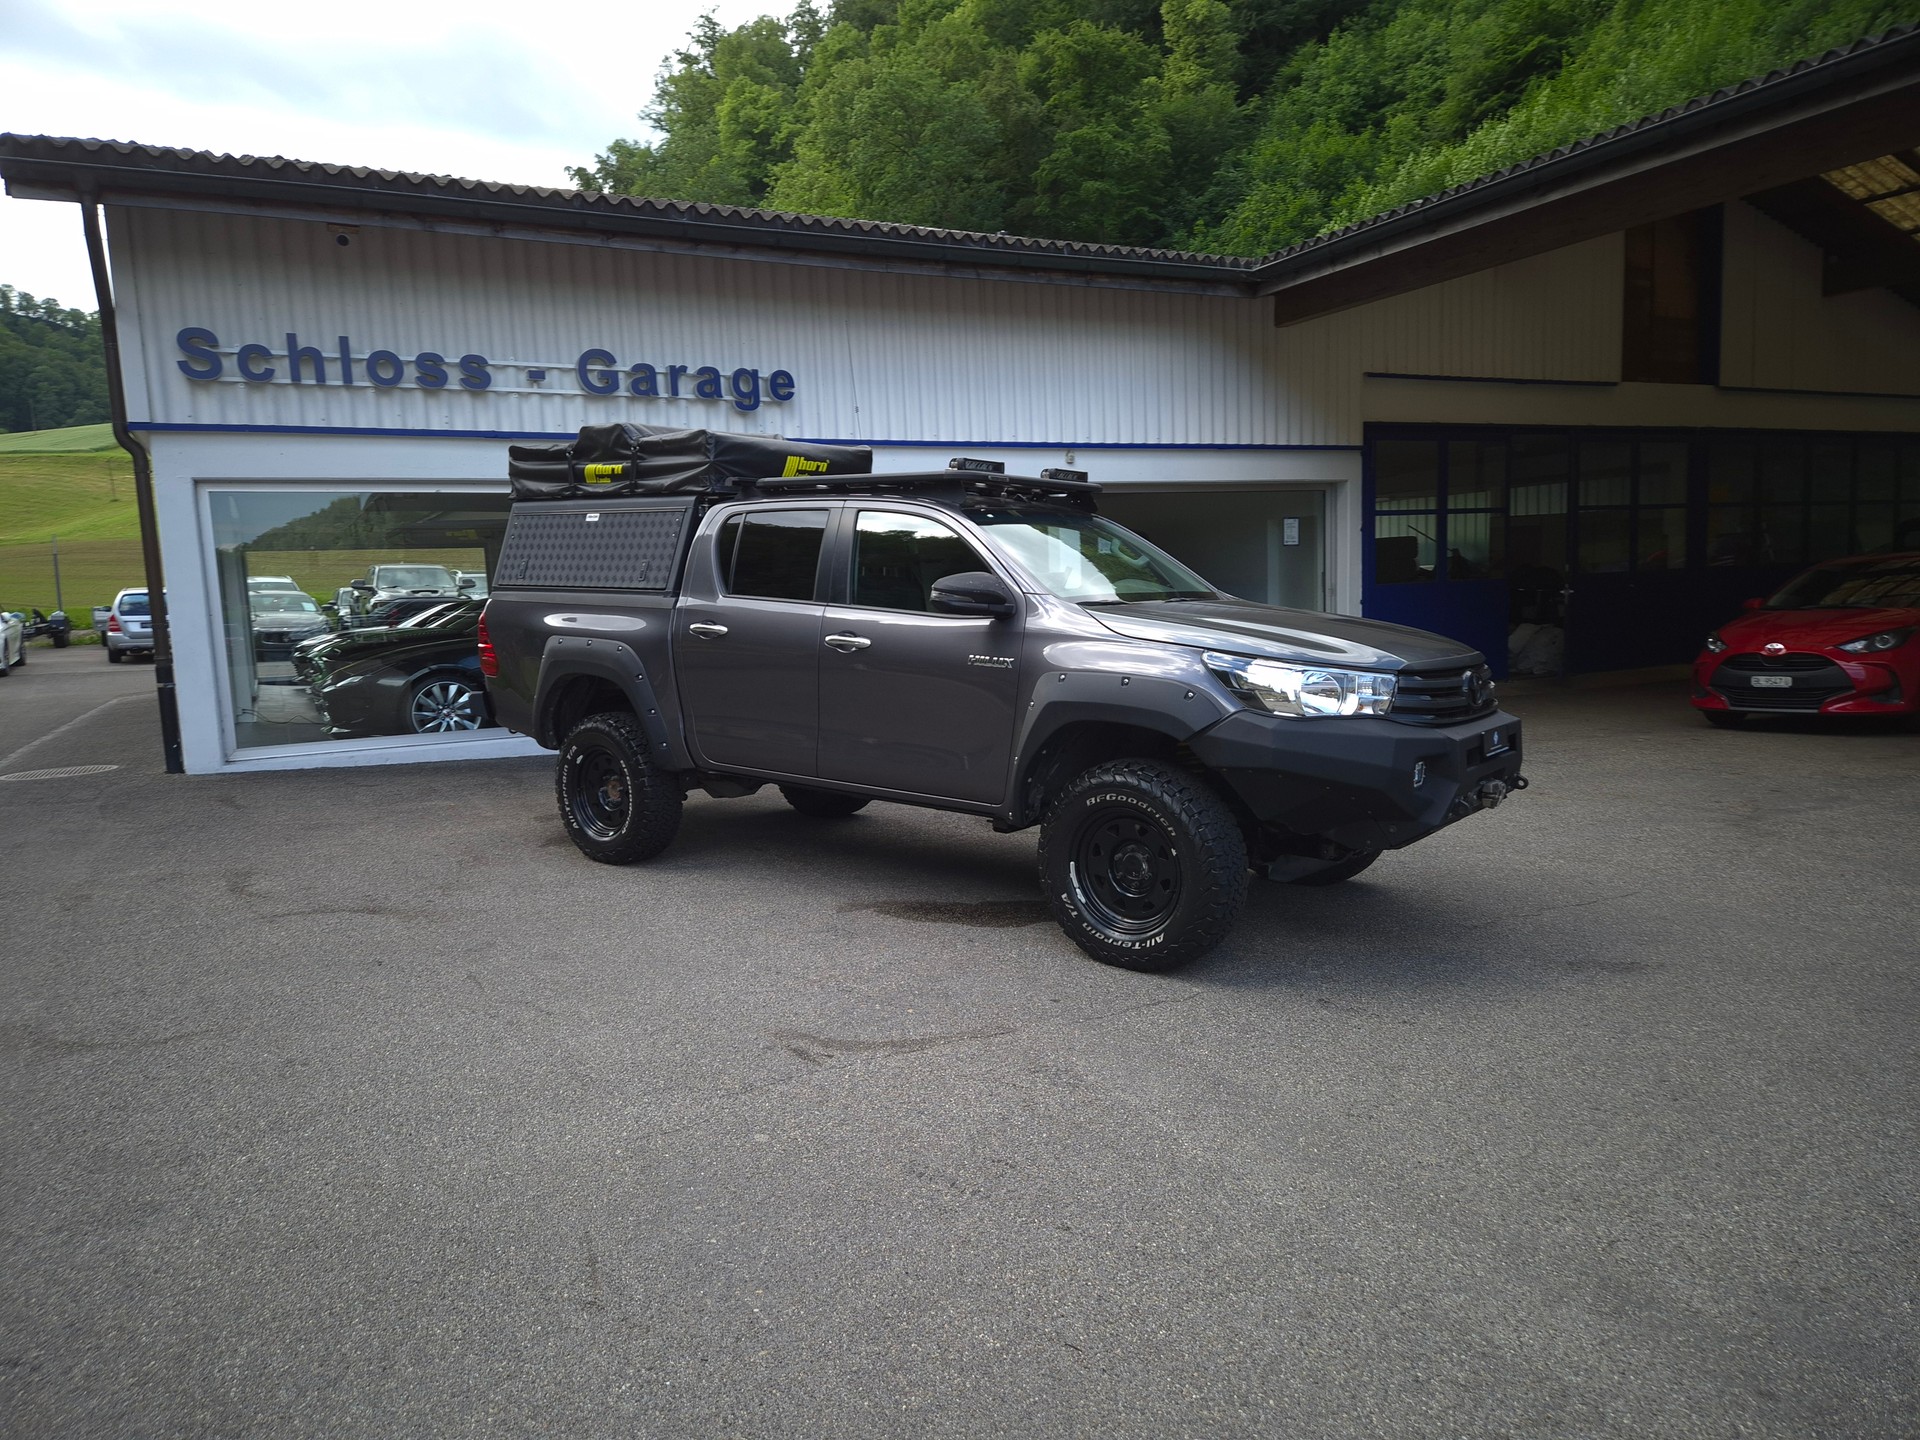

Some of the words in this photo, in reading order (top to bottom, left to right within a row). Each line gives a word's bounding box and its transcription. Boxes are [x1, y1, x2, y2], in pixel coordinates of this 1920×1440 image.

[176, 326, 492, 391] Schloss
[576, 348, 796, 412] Garage
[1086, 793, 1177, 837] BFGoodrich
[1081, 921, 1165, 950] All-Terrain
